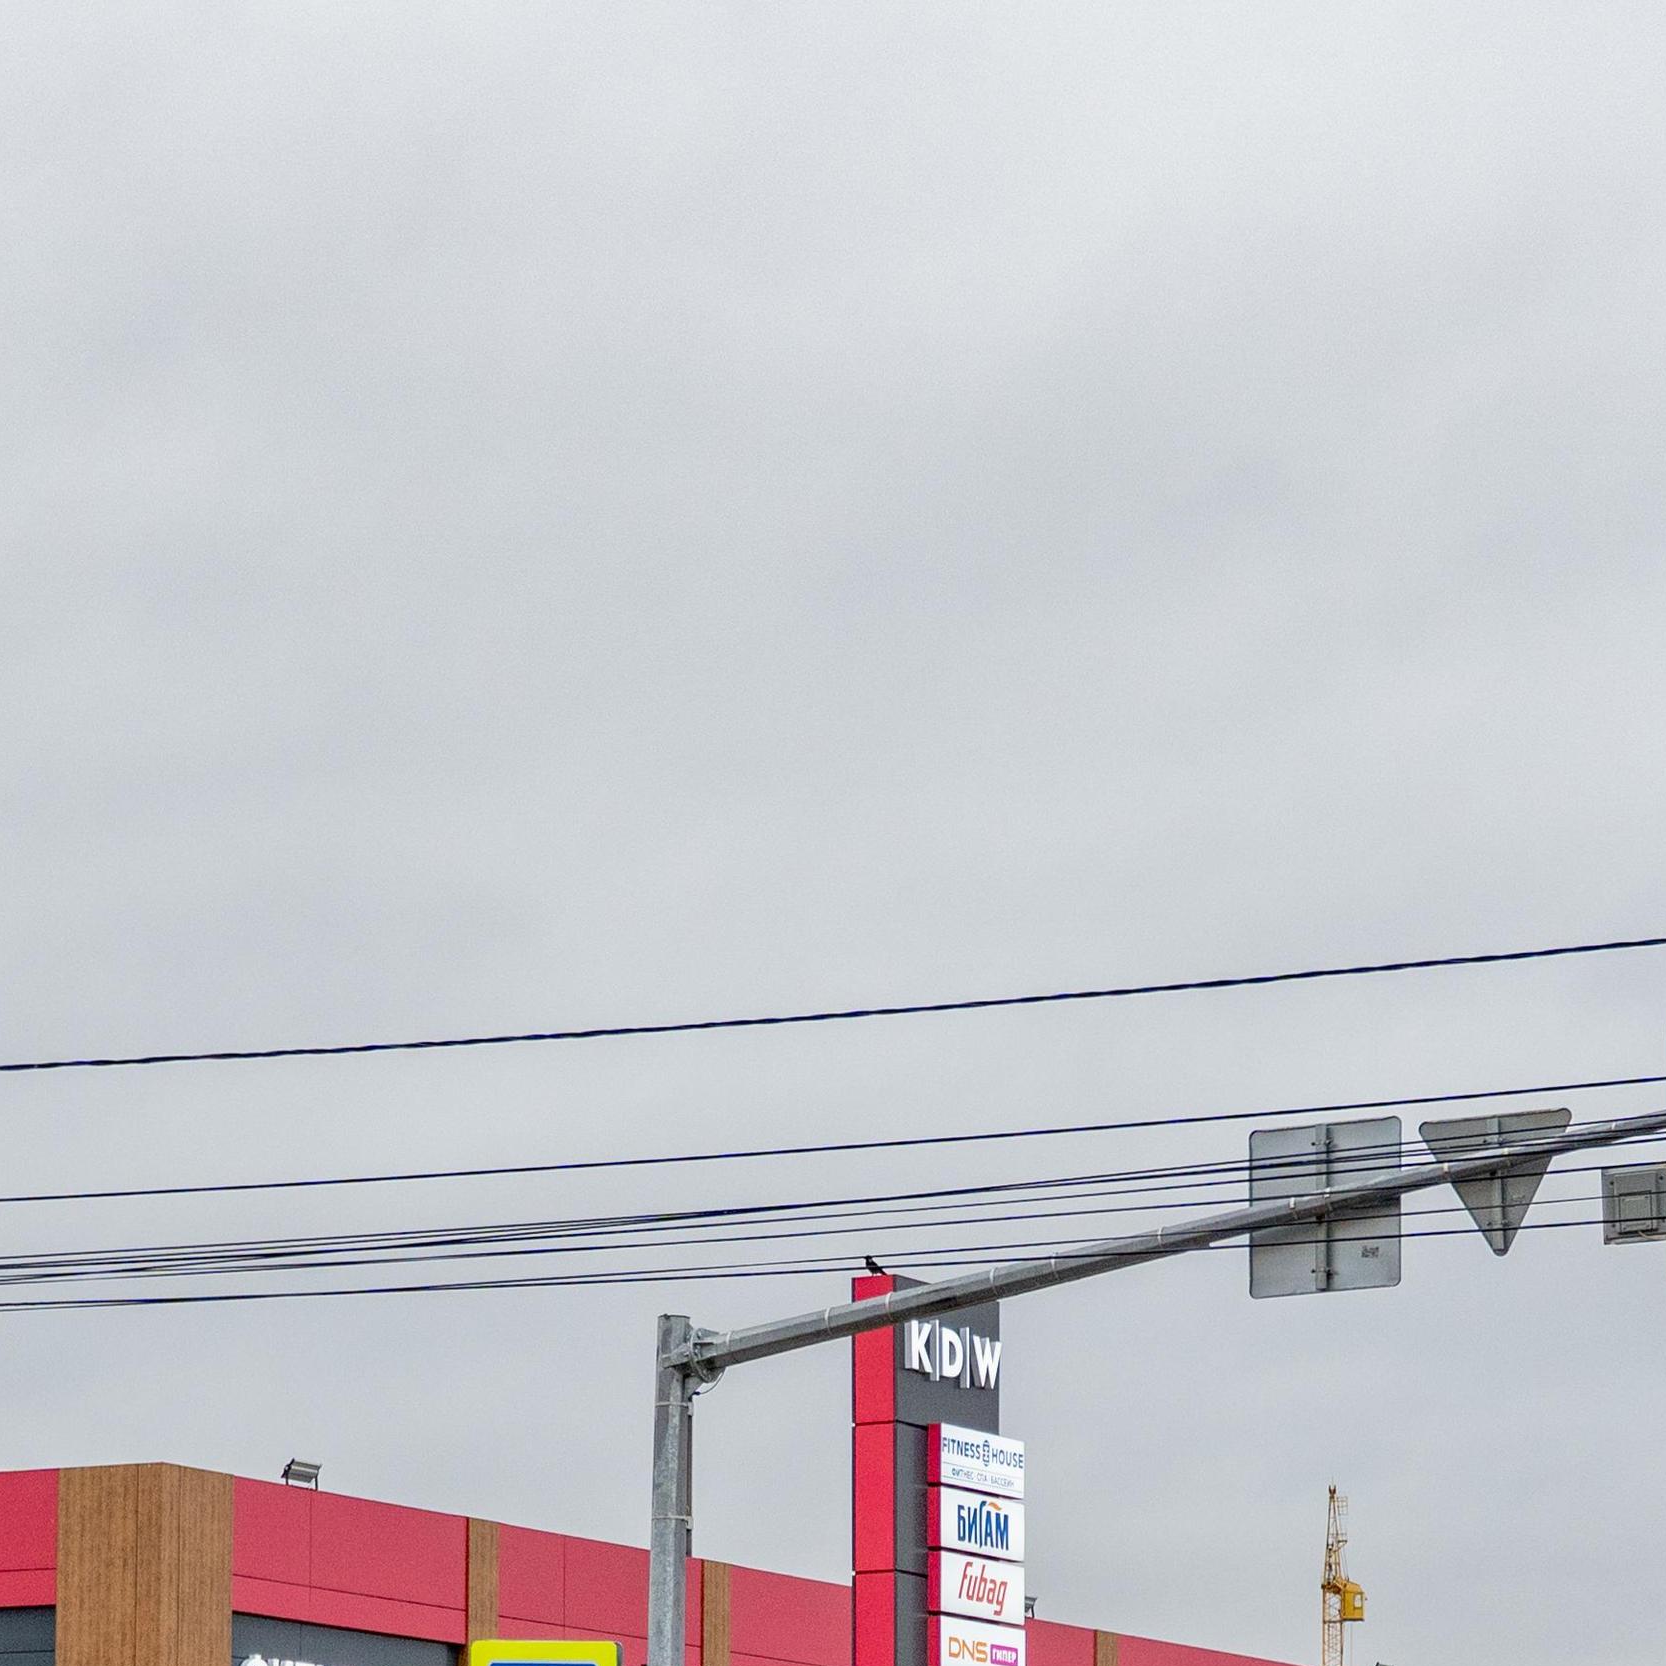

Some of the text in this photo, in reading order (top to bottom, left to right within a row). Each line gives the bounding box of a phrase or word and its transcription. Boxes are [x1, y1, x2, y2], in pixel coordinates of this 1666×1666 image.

[942, 1437, 1024, 1469] FITNESS HOUSE
[958, 1561, 1008, 1616] fubag
[948, 1636, 988, 1663] DNS
